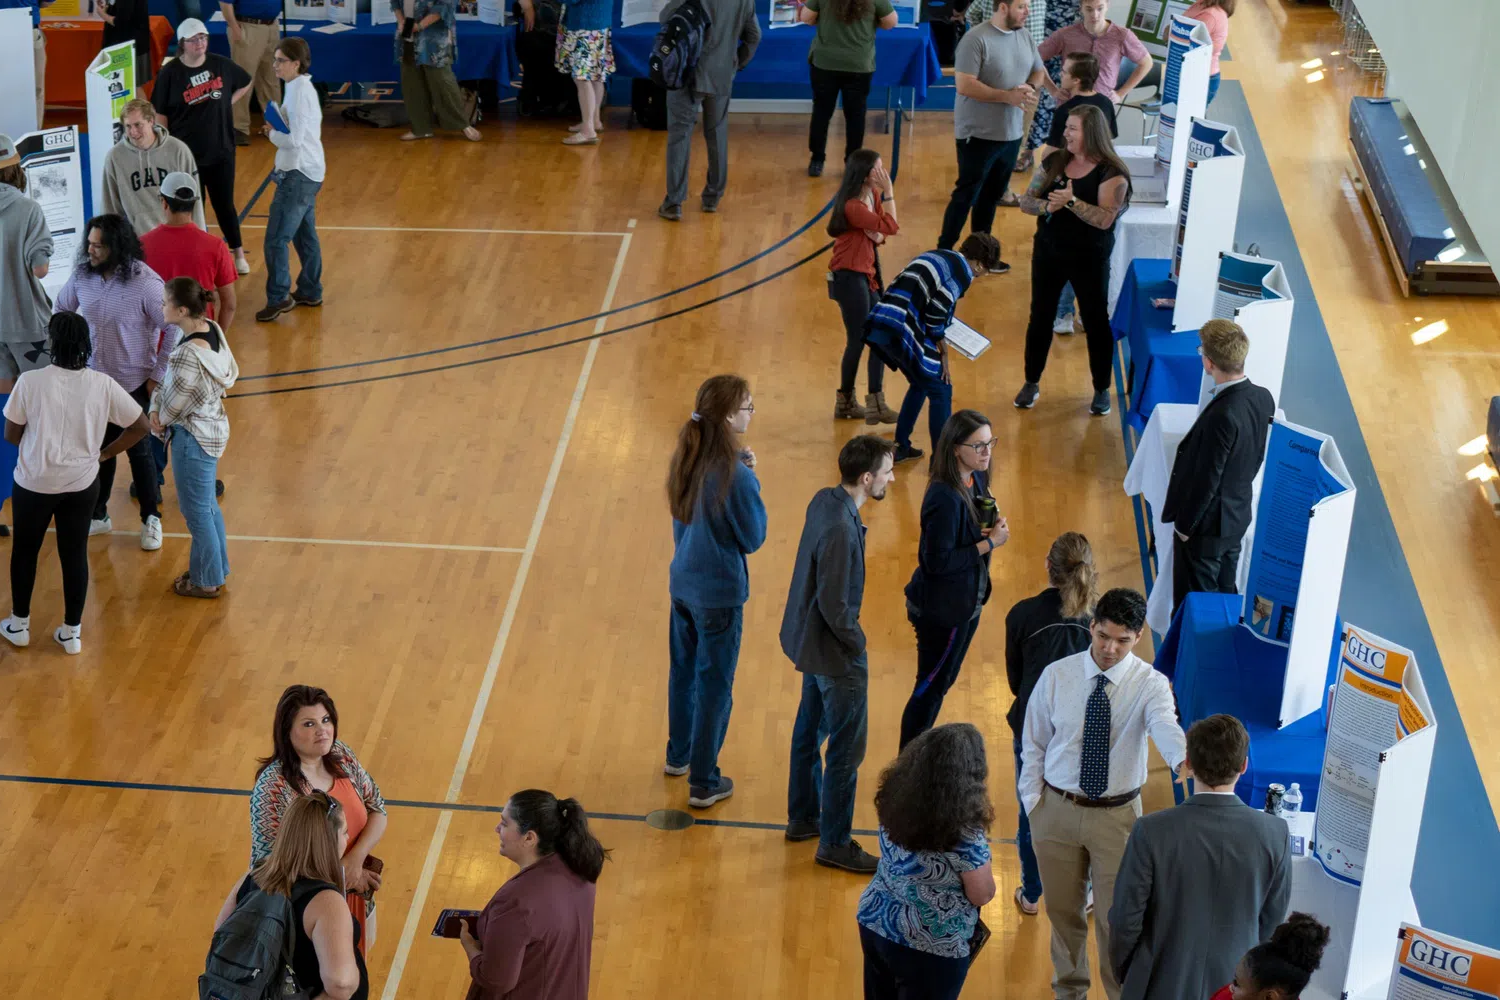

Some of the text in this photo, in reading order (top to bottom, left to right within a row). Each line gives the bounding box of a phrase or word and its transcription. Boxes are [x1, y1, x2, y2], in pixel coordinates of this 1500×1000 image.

[190, 70, 210, 87] KEEP
[183, 77, 223, 103] CHOPPING
[45, 132, 72, 146] GHC
[1189, 141, 1213, 158] GHC
[1288, 440, 1319, 459] Comparing
[1348, 636, 1385, 669] GHC
[1360, 682, 1393, 699] Introduction
[1411, 940, 1470, 976] GHC
[1442, 985, 1474, 997] Introduction
